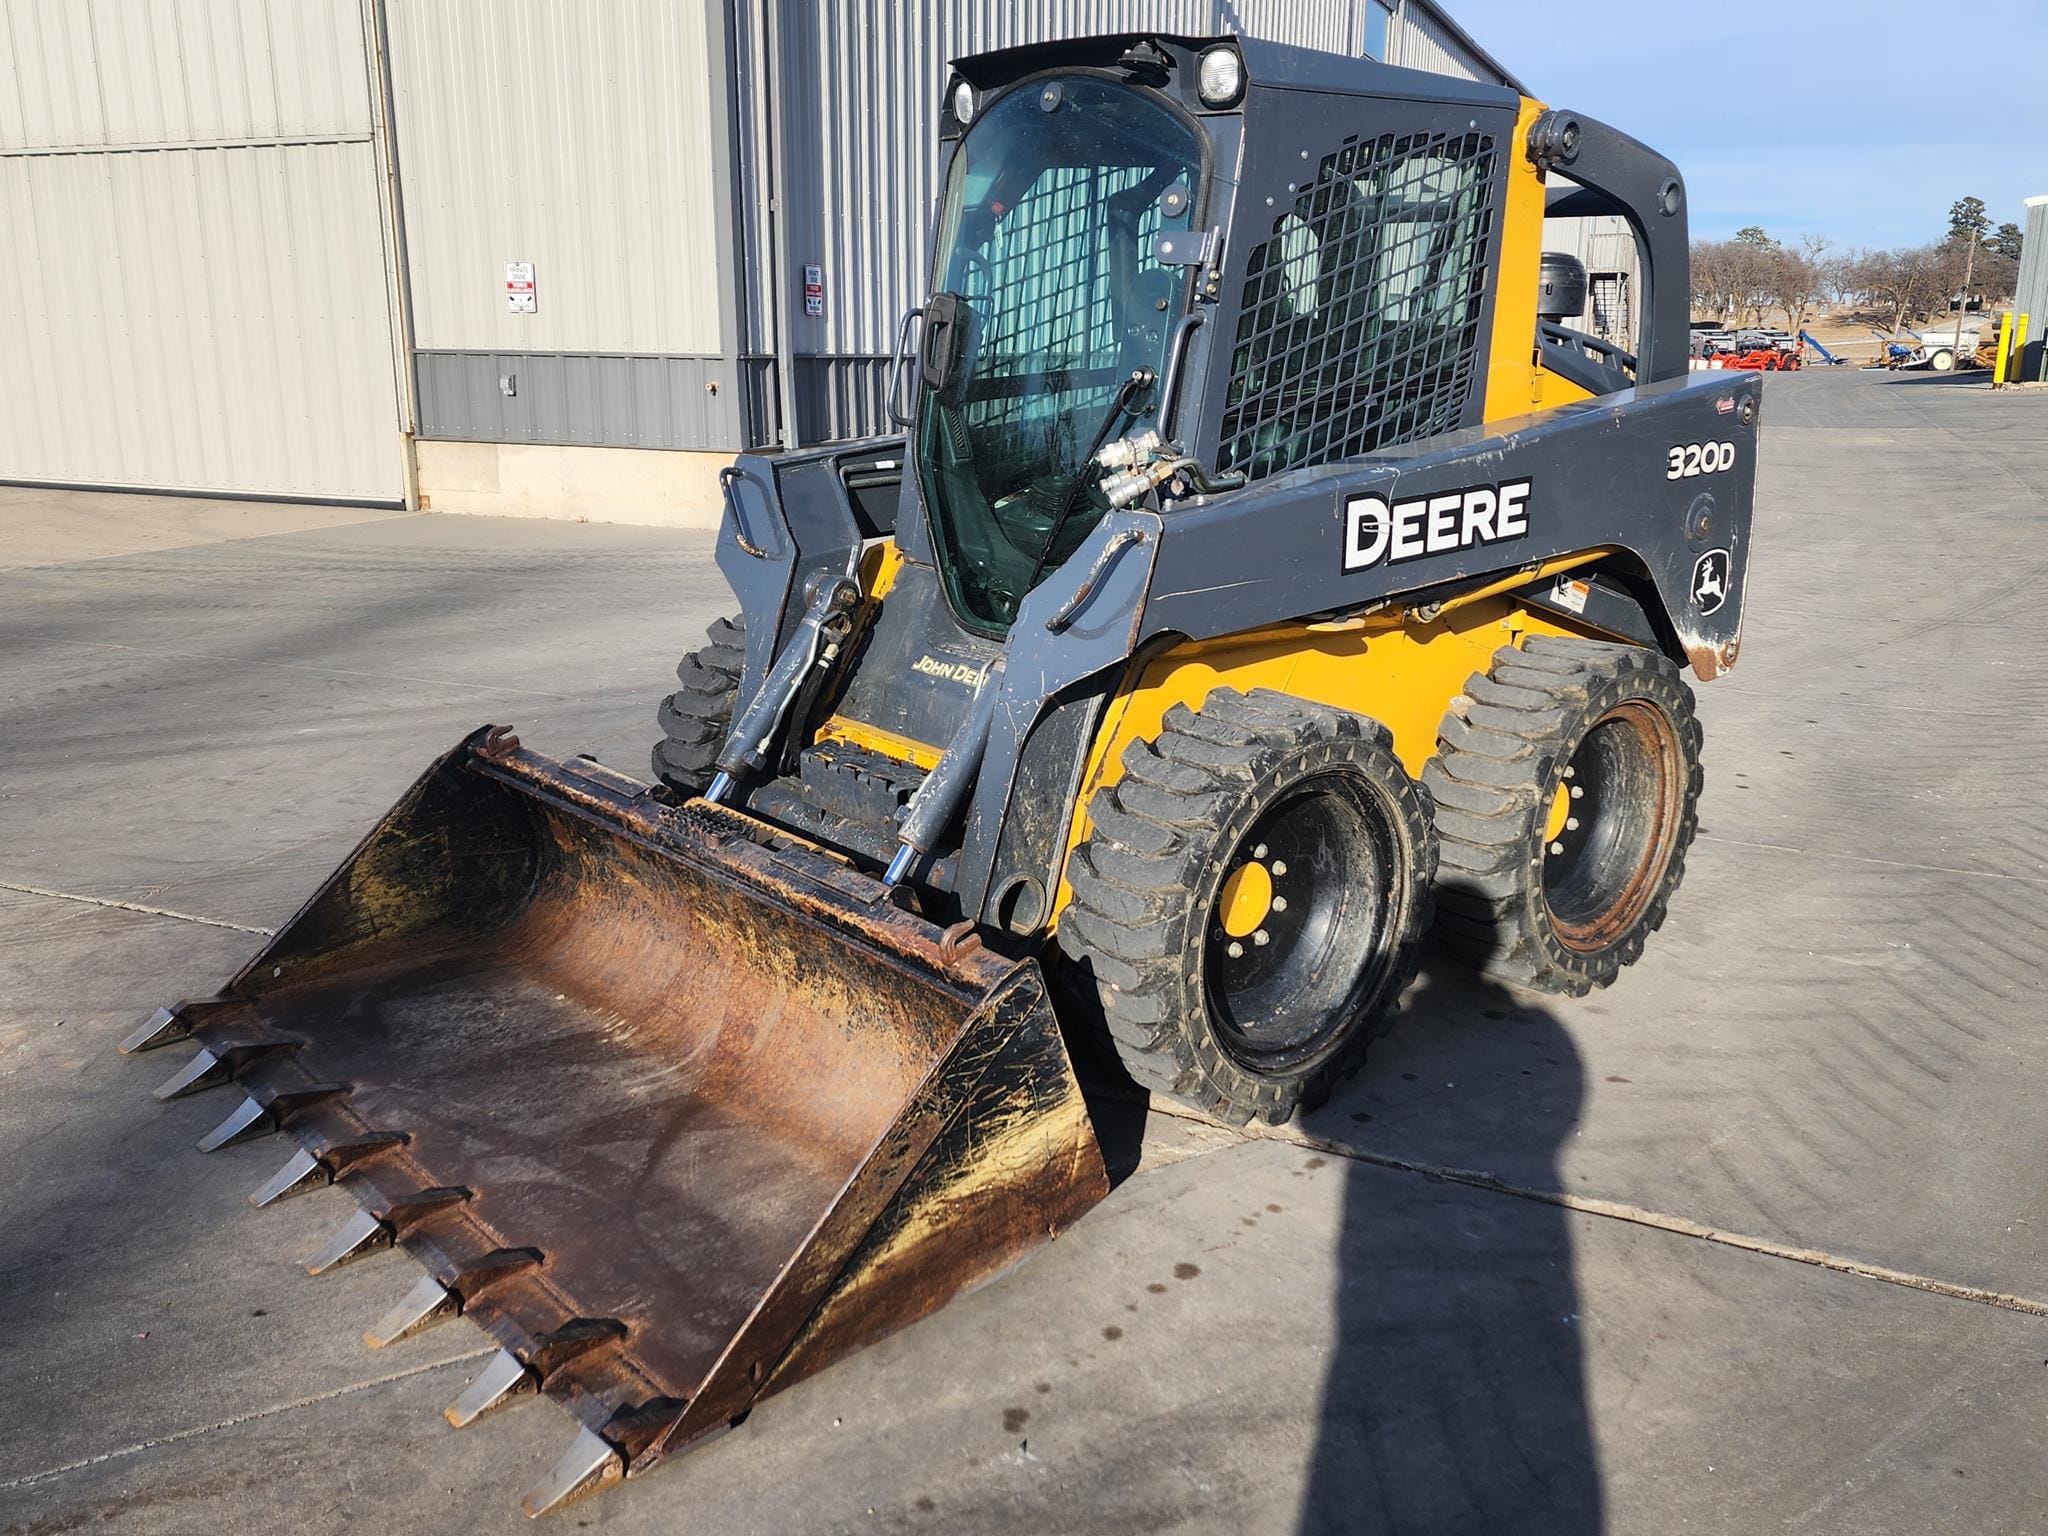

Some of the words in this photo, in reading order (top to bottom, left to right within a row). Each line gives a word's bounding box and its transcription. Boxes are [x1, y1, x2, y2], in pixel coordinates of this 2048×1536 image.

[1666, 440, 1735, 480] 320D
[1343, 480, 1531, 571] DEERE
[911, 655, 955, 678] JOHN
